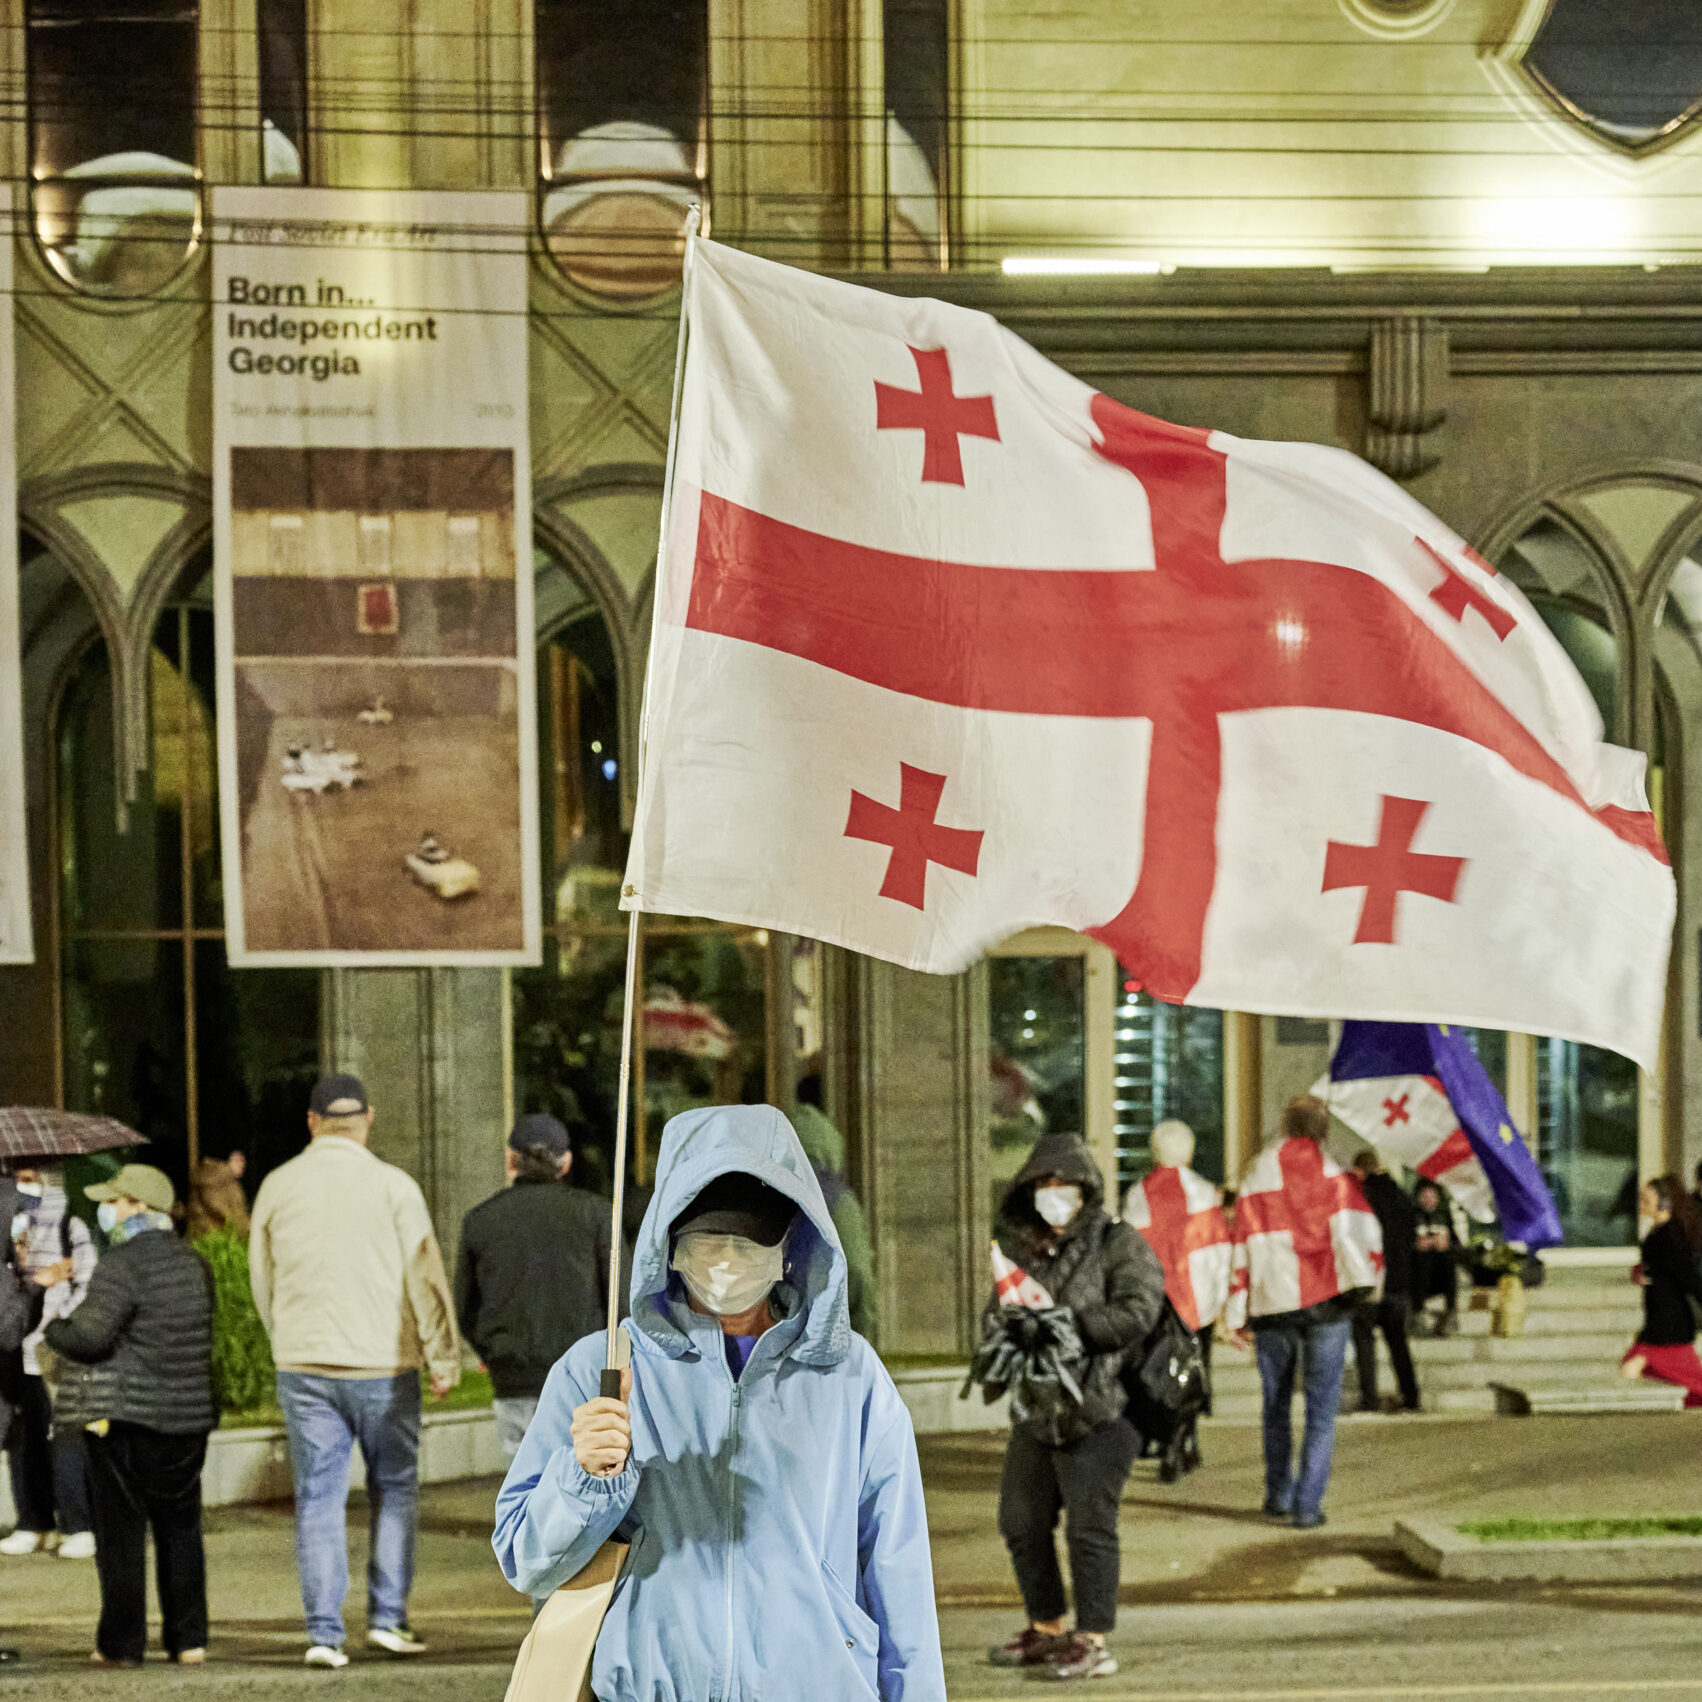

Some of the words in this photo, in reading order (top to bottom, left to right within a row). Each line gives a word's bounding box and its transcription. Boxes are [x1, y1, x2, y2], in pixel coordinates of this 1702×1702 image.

[228, 277, 306, 305] Born
[317, 278, 374, 306] in...
[228, 312, 438, 345] Independent
[229, 347, 360, 382] Georgia
